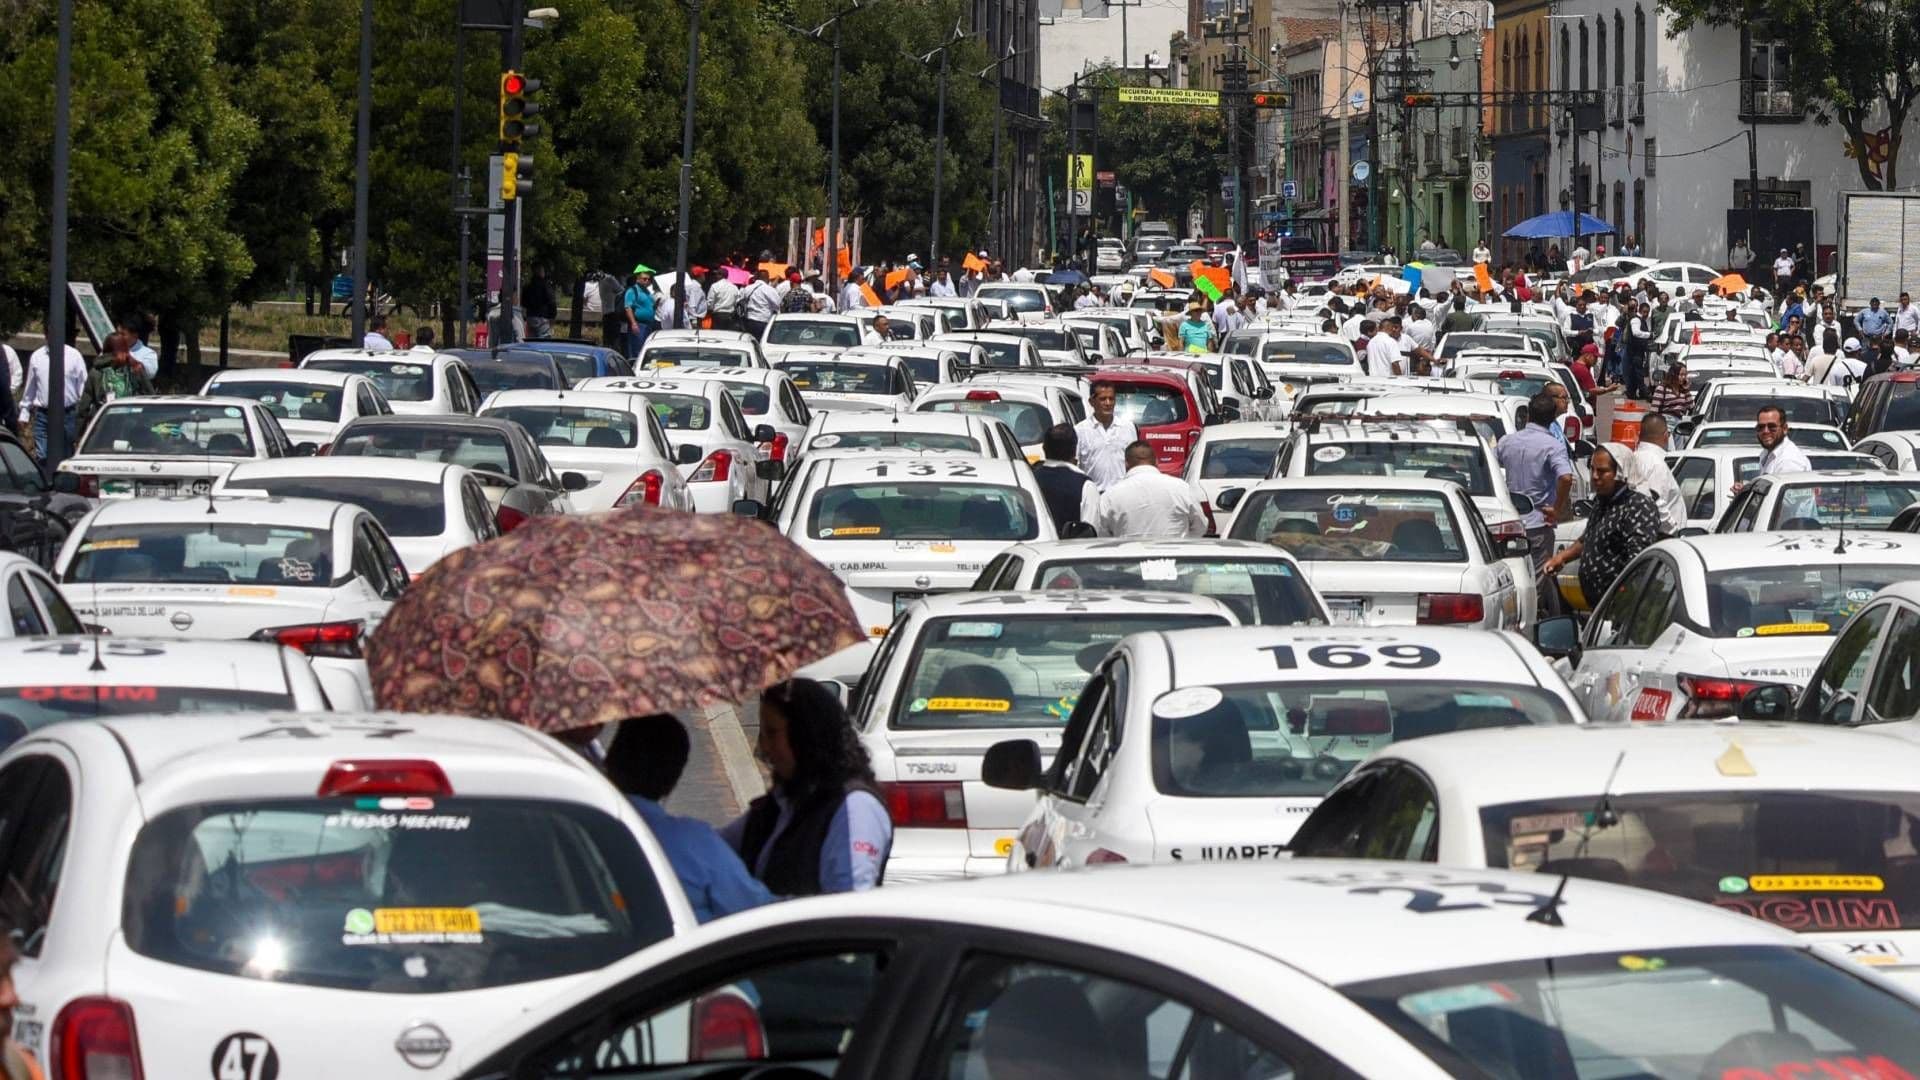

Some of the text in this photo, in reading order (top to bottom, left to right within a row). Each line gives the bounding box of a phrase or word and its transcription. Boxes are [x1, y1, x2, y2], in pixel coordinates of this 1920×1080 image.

[605, 381, 679, 390] 405
[866, 465, 978, 477] 132
[1256, 644, 1442, 670] 169
[1740, 669, 1788, 677] VERSA
[18, 685, 158, 700] OCIM
[906, 763, 957, 773] TSURU
[399, 814, 471, 830] MIENTEN
[218, 1036, 270, 1080] 47
